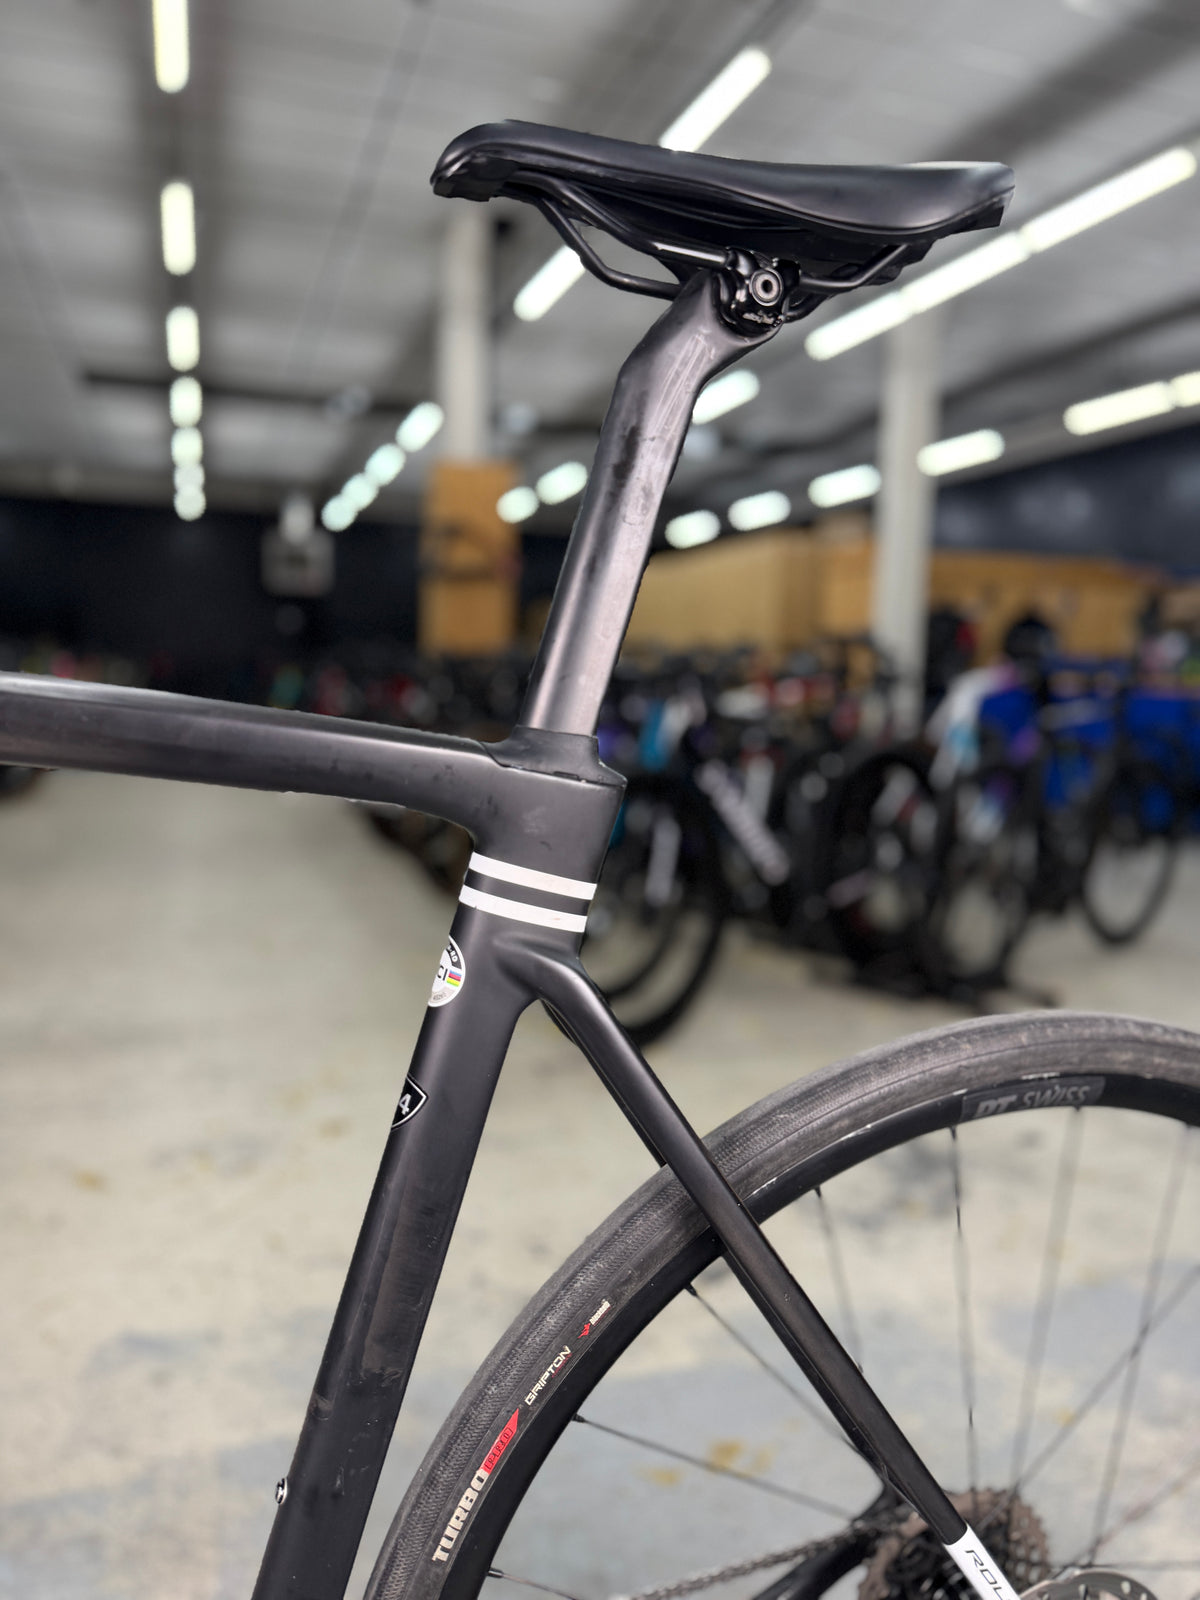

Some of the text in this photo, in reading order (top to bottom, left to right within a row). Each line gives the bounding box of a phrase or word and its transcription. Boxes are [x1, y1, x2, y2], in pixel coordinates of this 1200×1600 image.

[399, 1093, 412, 1116] 4
[973, 1095, 1018, 1119] DT
[524, 1345, 572, 1406] GRIPTON
[431, 1426, 514, 1563] TURBO PRO
[965, 1549, 1012, 1600] ROL
